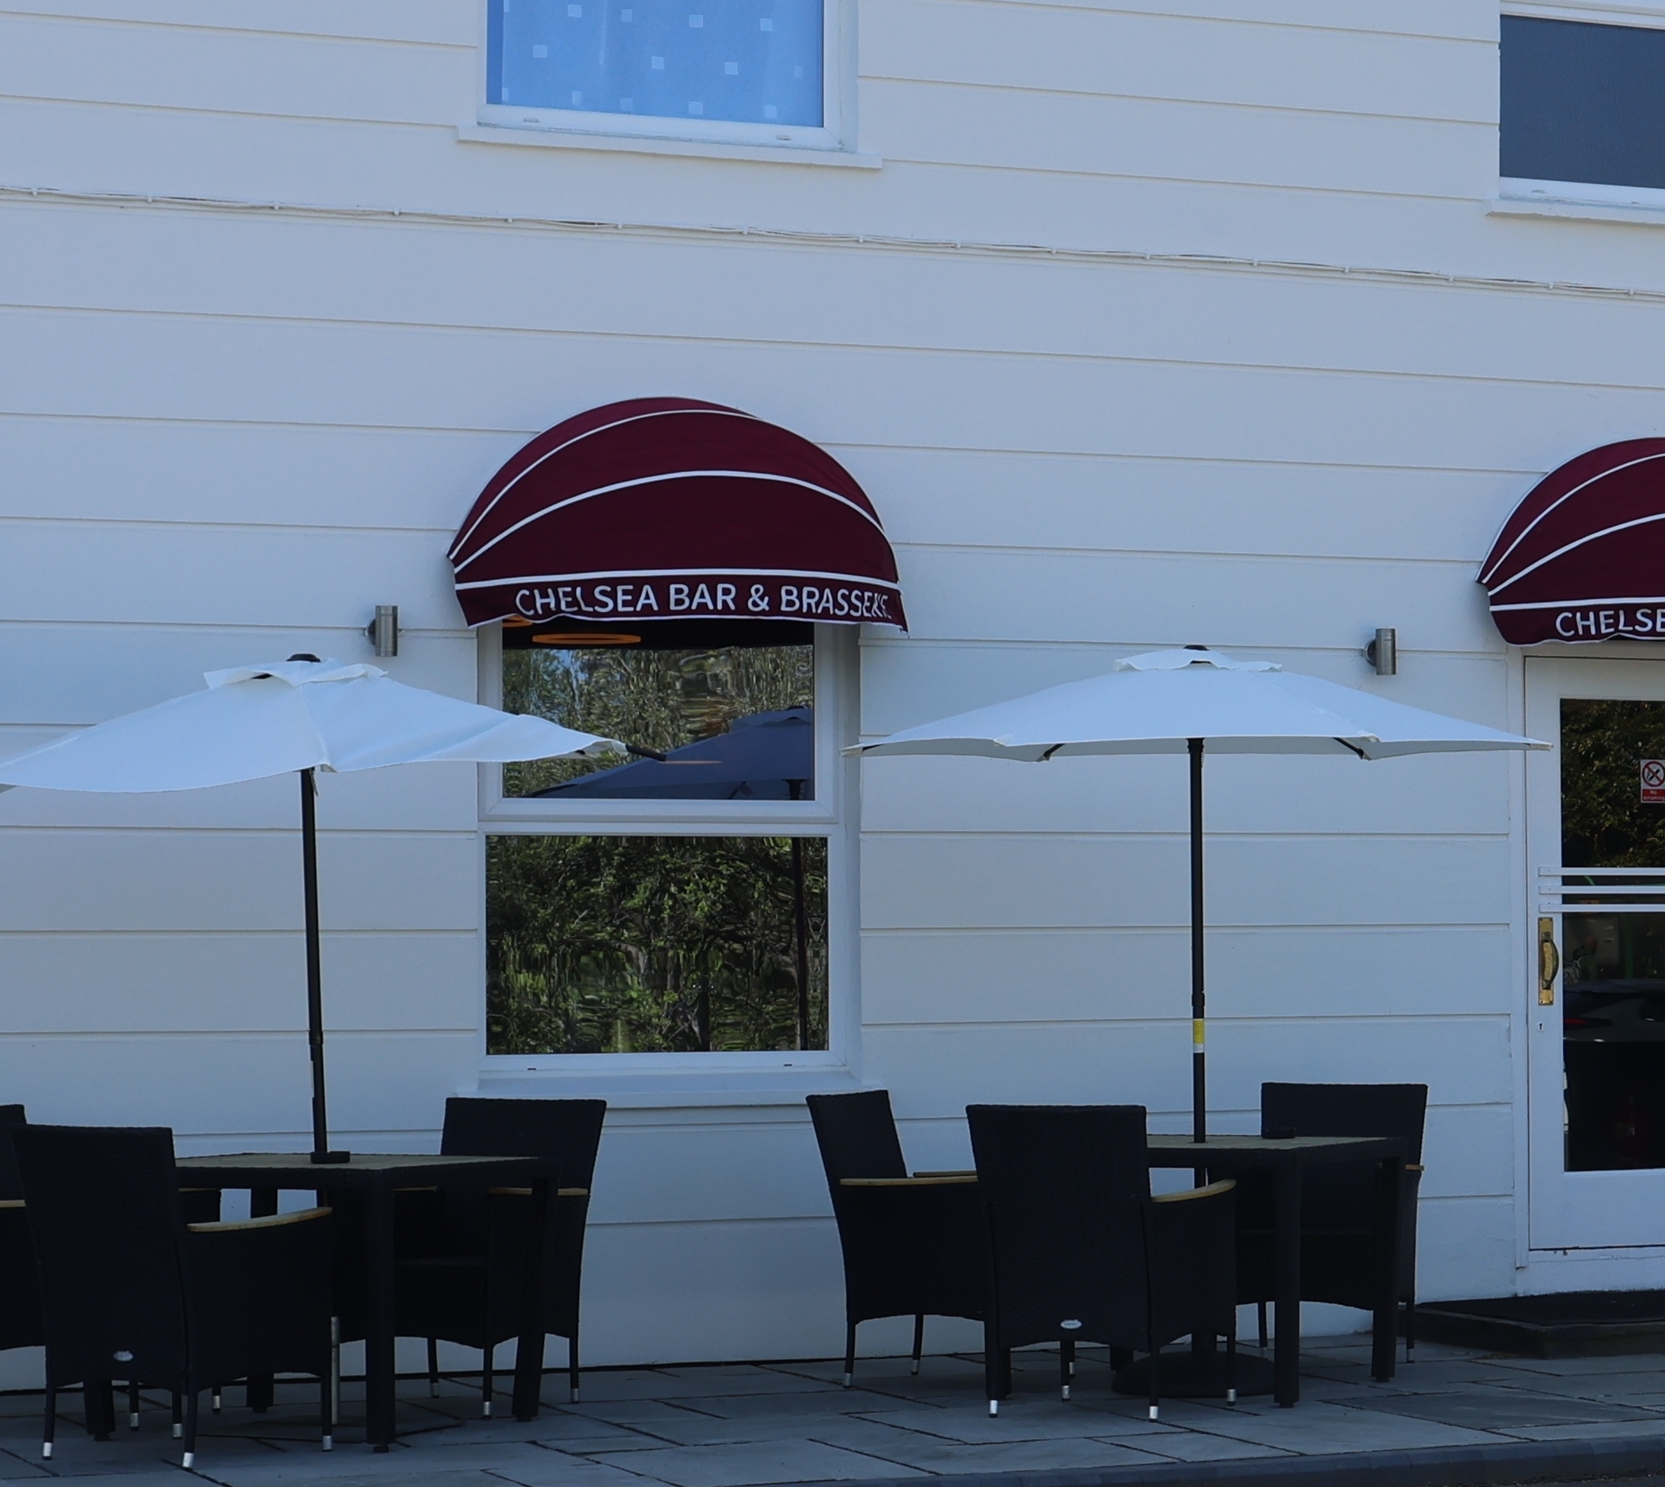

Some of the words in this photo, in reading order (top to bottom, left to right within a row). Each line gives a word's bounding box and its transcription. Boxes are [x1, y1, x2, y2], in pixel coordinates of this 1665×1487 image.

[515, 584, 659, 616] CHELSEA
[668, 582, 736, 611] BAR
[747, 584, 770, 612] &
